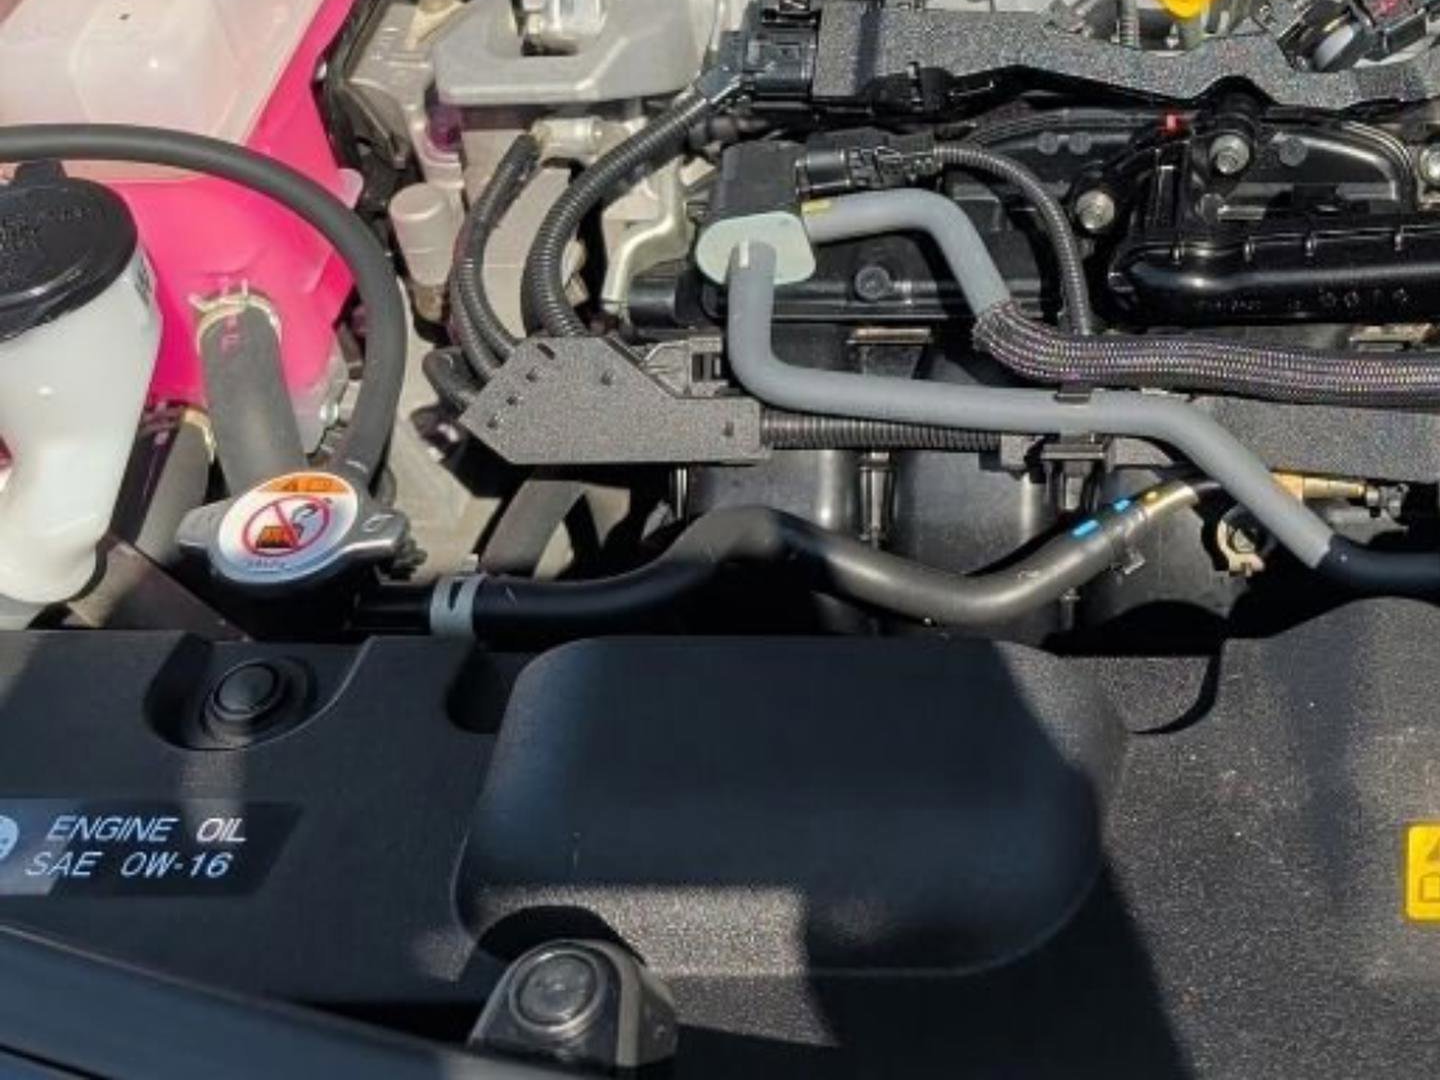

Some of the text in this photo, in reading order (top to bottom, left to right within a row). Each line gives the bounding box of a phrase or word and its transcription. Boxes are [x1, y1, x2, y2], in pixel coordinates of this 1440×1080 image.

[46, 815, 247, 843] ENGINE OIL
[25, 851, 235, 878] SAE 0W-16
